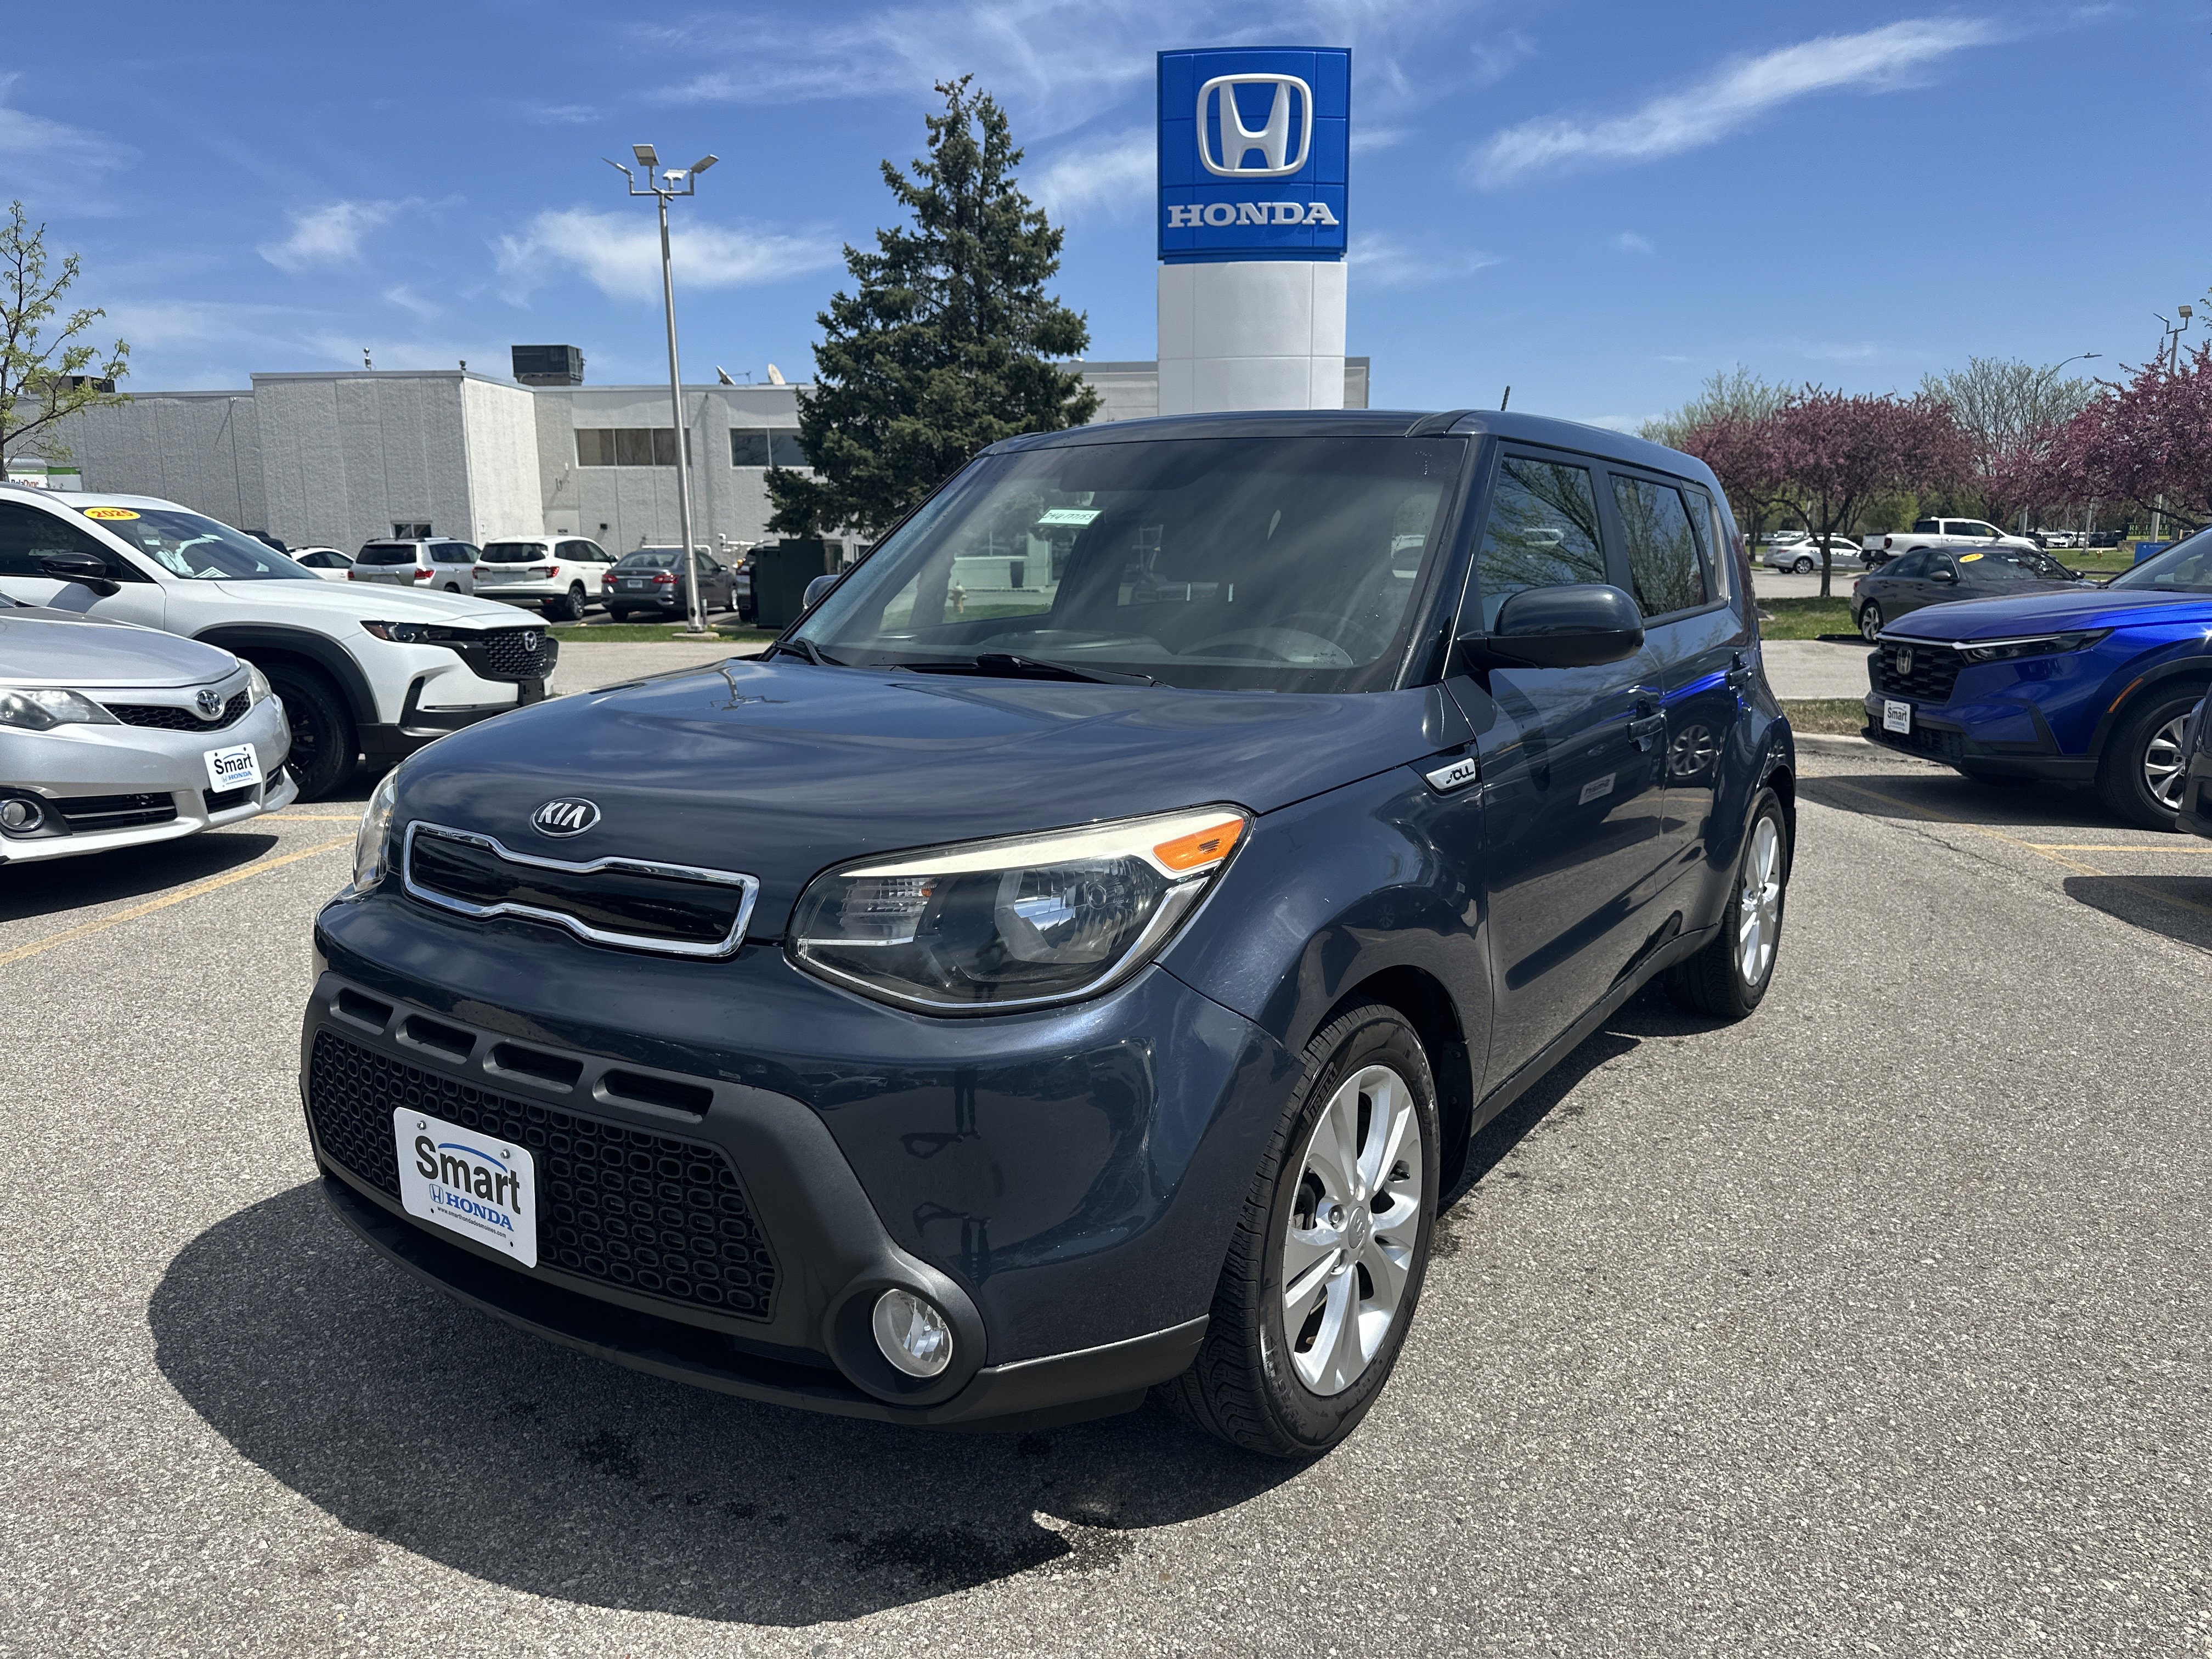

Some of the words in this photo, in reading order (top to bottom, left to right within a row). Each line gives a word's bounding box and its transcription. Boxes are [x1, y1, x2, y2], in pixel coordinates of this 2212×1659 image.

[1167, 202, 1339, 228] HONDA
[1887, 707, 1907, 721] Smart
[214, 754, 253, 775] Smart
[228, 771, 252, 780] HONDA
[538, 802, 586, 828] KIA
[1303, 1061, 1339, 1126] PIRELLI
[415, 1135, 521, 1215] Smart
[445, 1191, 514, 1232] HONDA
